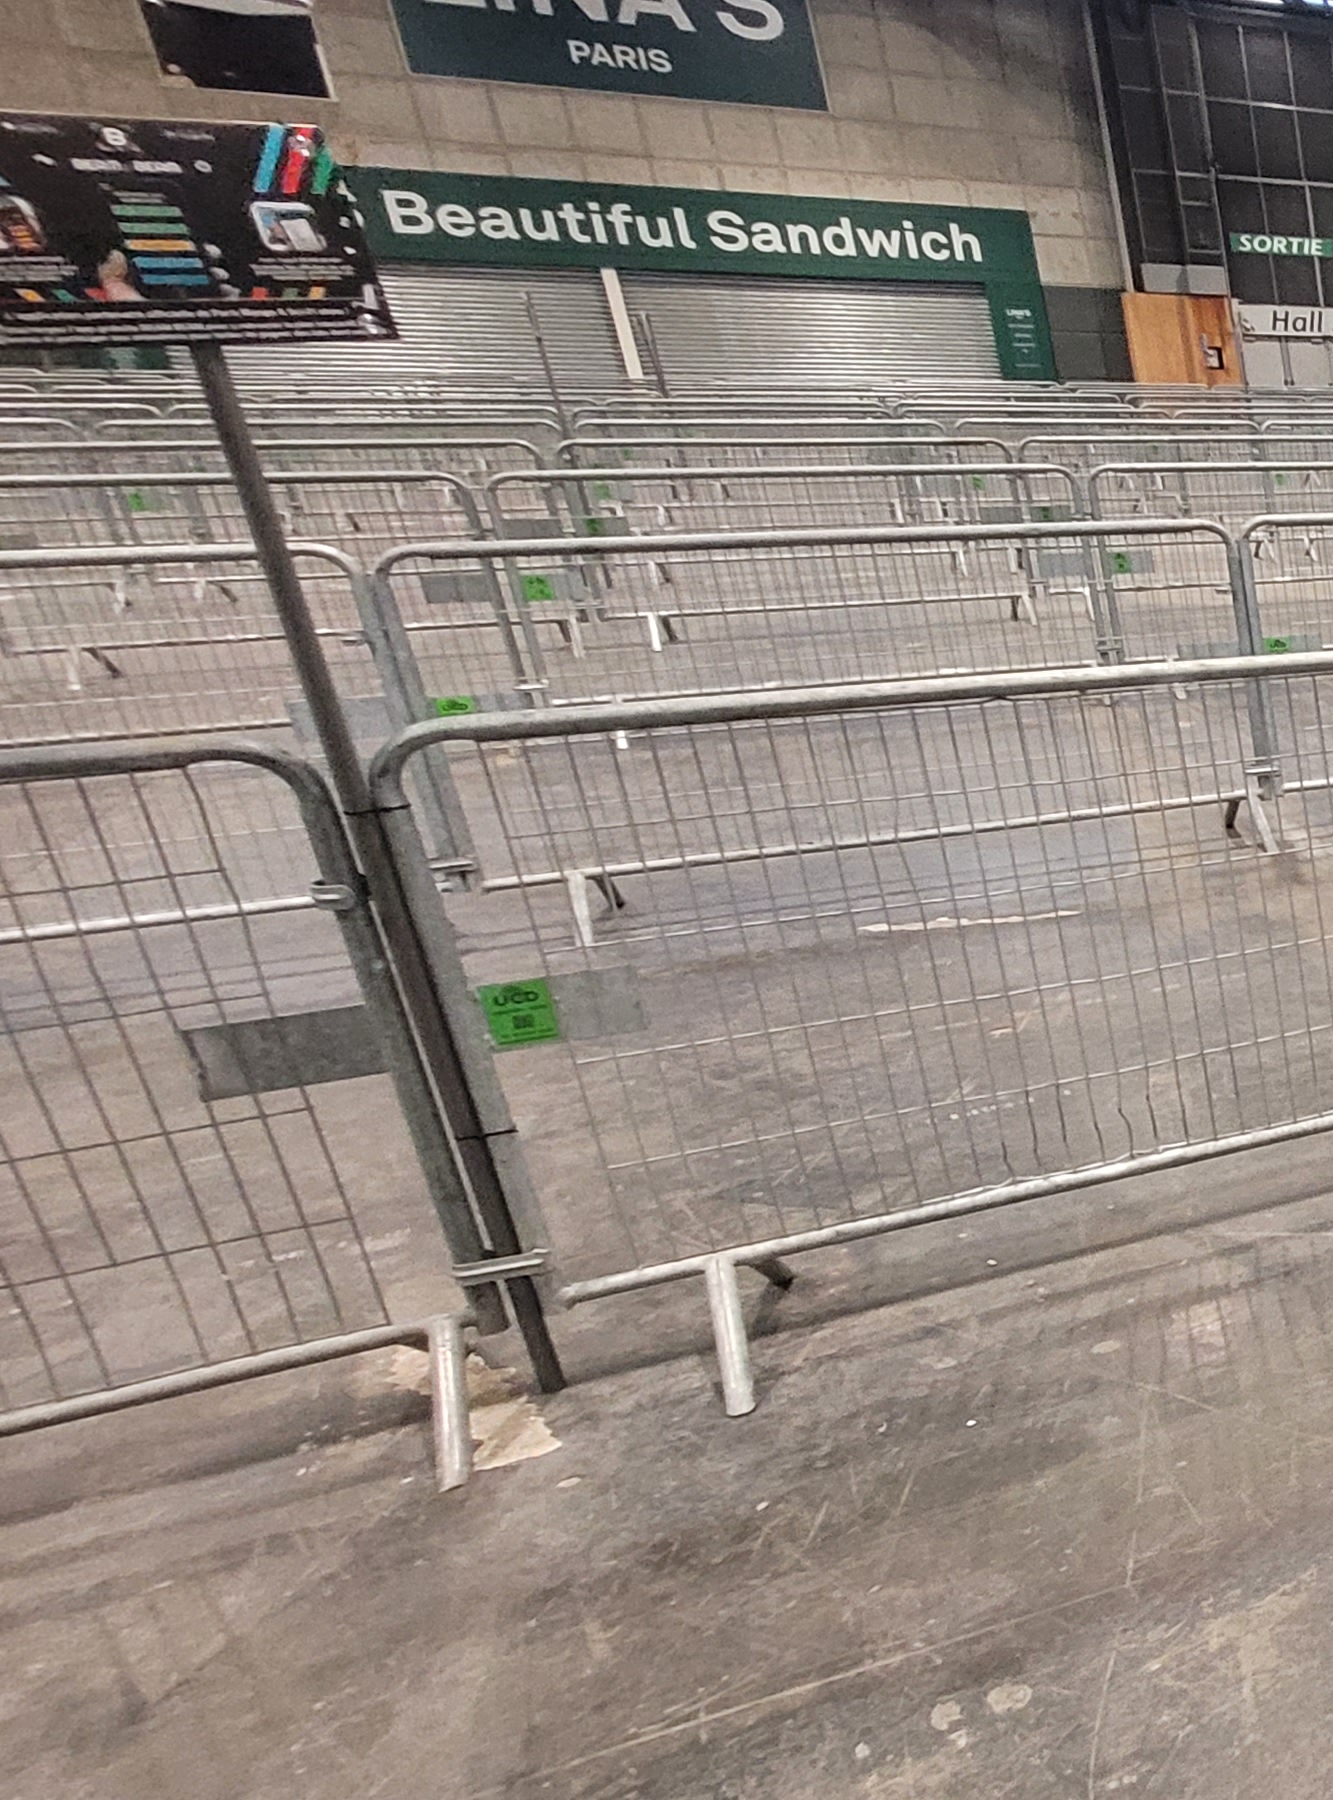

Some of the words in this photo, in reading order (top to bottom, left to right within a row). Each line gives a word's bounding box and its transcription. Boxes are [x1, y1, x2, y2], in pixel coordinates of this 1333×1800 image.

[566, 39, 674, 74] PARIS
[379, 188, 698, 249] Beautiful
[708, 210, 984, 263] Sandwich
[1239, 234, 1323, 257] SORTIE
[1271, 310, 1323, 333] Hall
